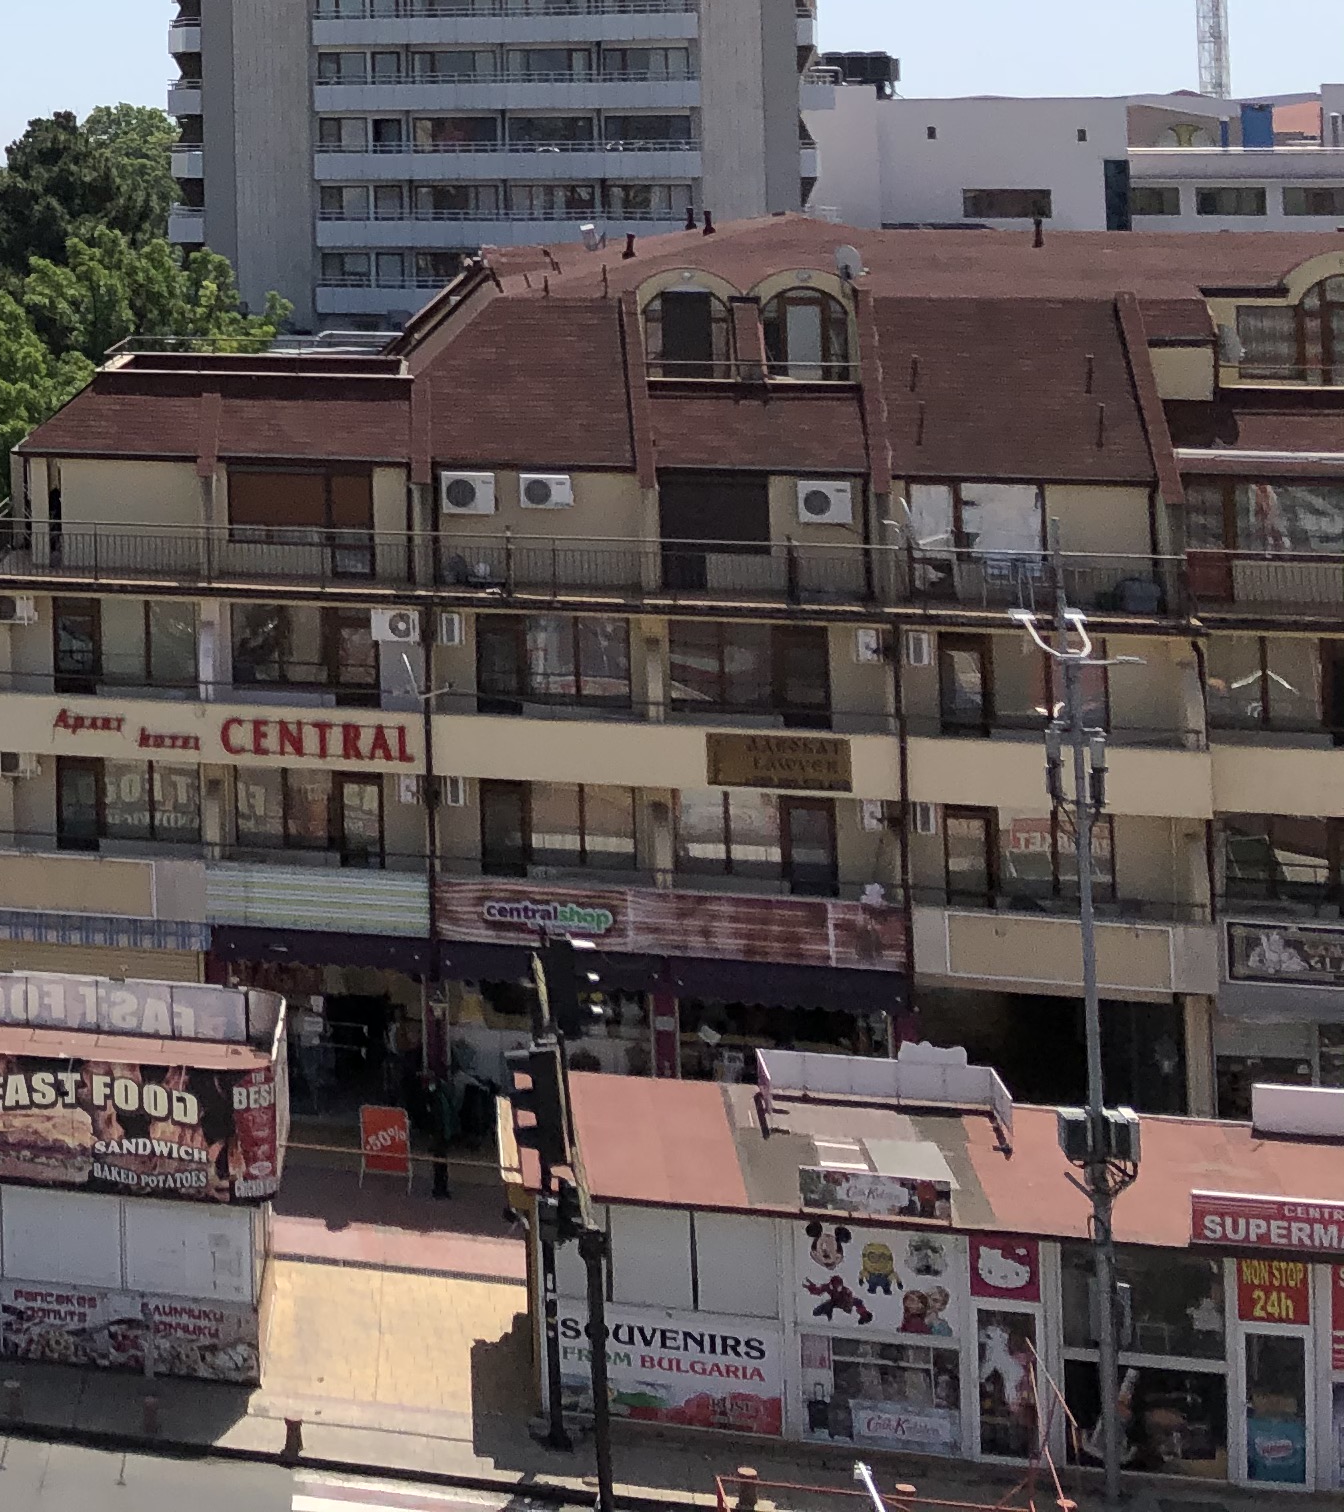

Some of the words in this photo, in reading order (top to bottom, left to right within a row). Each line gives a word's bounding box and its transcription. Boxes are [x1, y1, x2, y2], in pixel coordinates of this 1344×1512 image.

[219, 716, 416, 764] CENTRAL
[91, 1074, 200, 1125] FOOD
[94, 1137, 208, 1164] SANDWICH
[93, 1163, 139, 1186] BAKED
[140, 1170, 208, 1189] POTATOES
[1203, 1214, 1344, 1250] SUPERM
[1241, 1259, 1269, 1286] NON
[1272, 1260, 1304, 1288] STOP
[1252, 1290, 1294, 1320] 24h
[561, 1317, 766, 1361] SUVENIRS
[639, 1354, 766, 1382] BULGARIA
